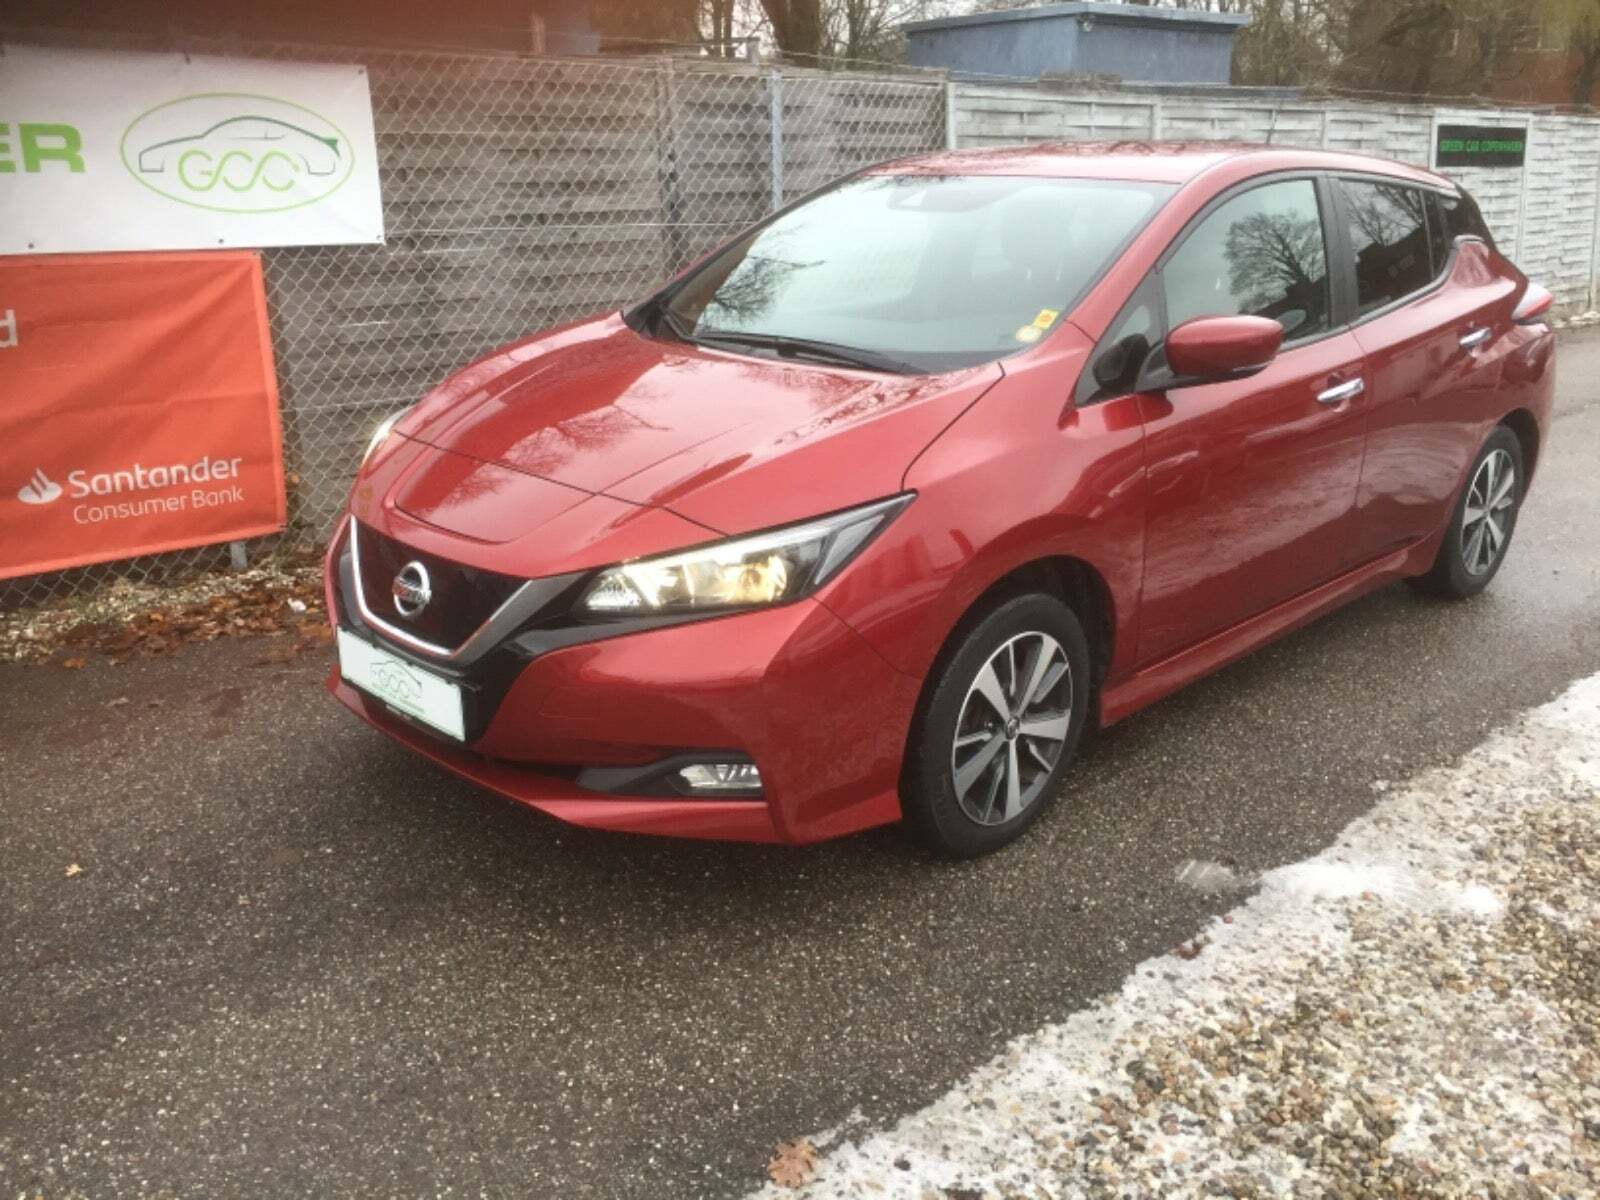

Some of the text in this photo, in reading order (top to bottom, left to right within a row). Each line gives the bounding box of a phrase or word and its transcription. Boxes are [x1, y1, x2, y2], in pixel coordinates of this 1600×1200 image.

[0, 123, 86, 173] R
[68, 456, 242, 498] Santander
[73, 486, 244, 524] Consumer Bank
